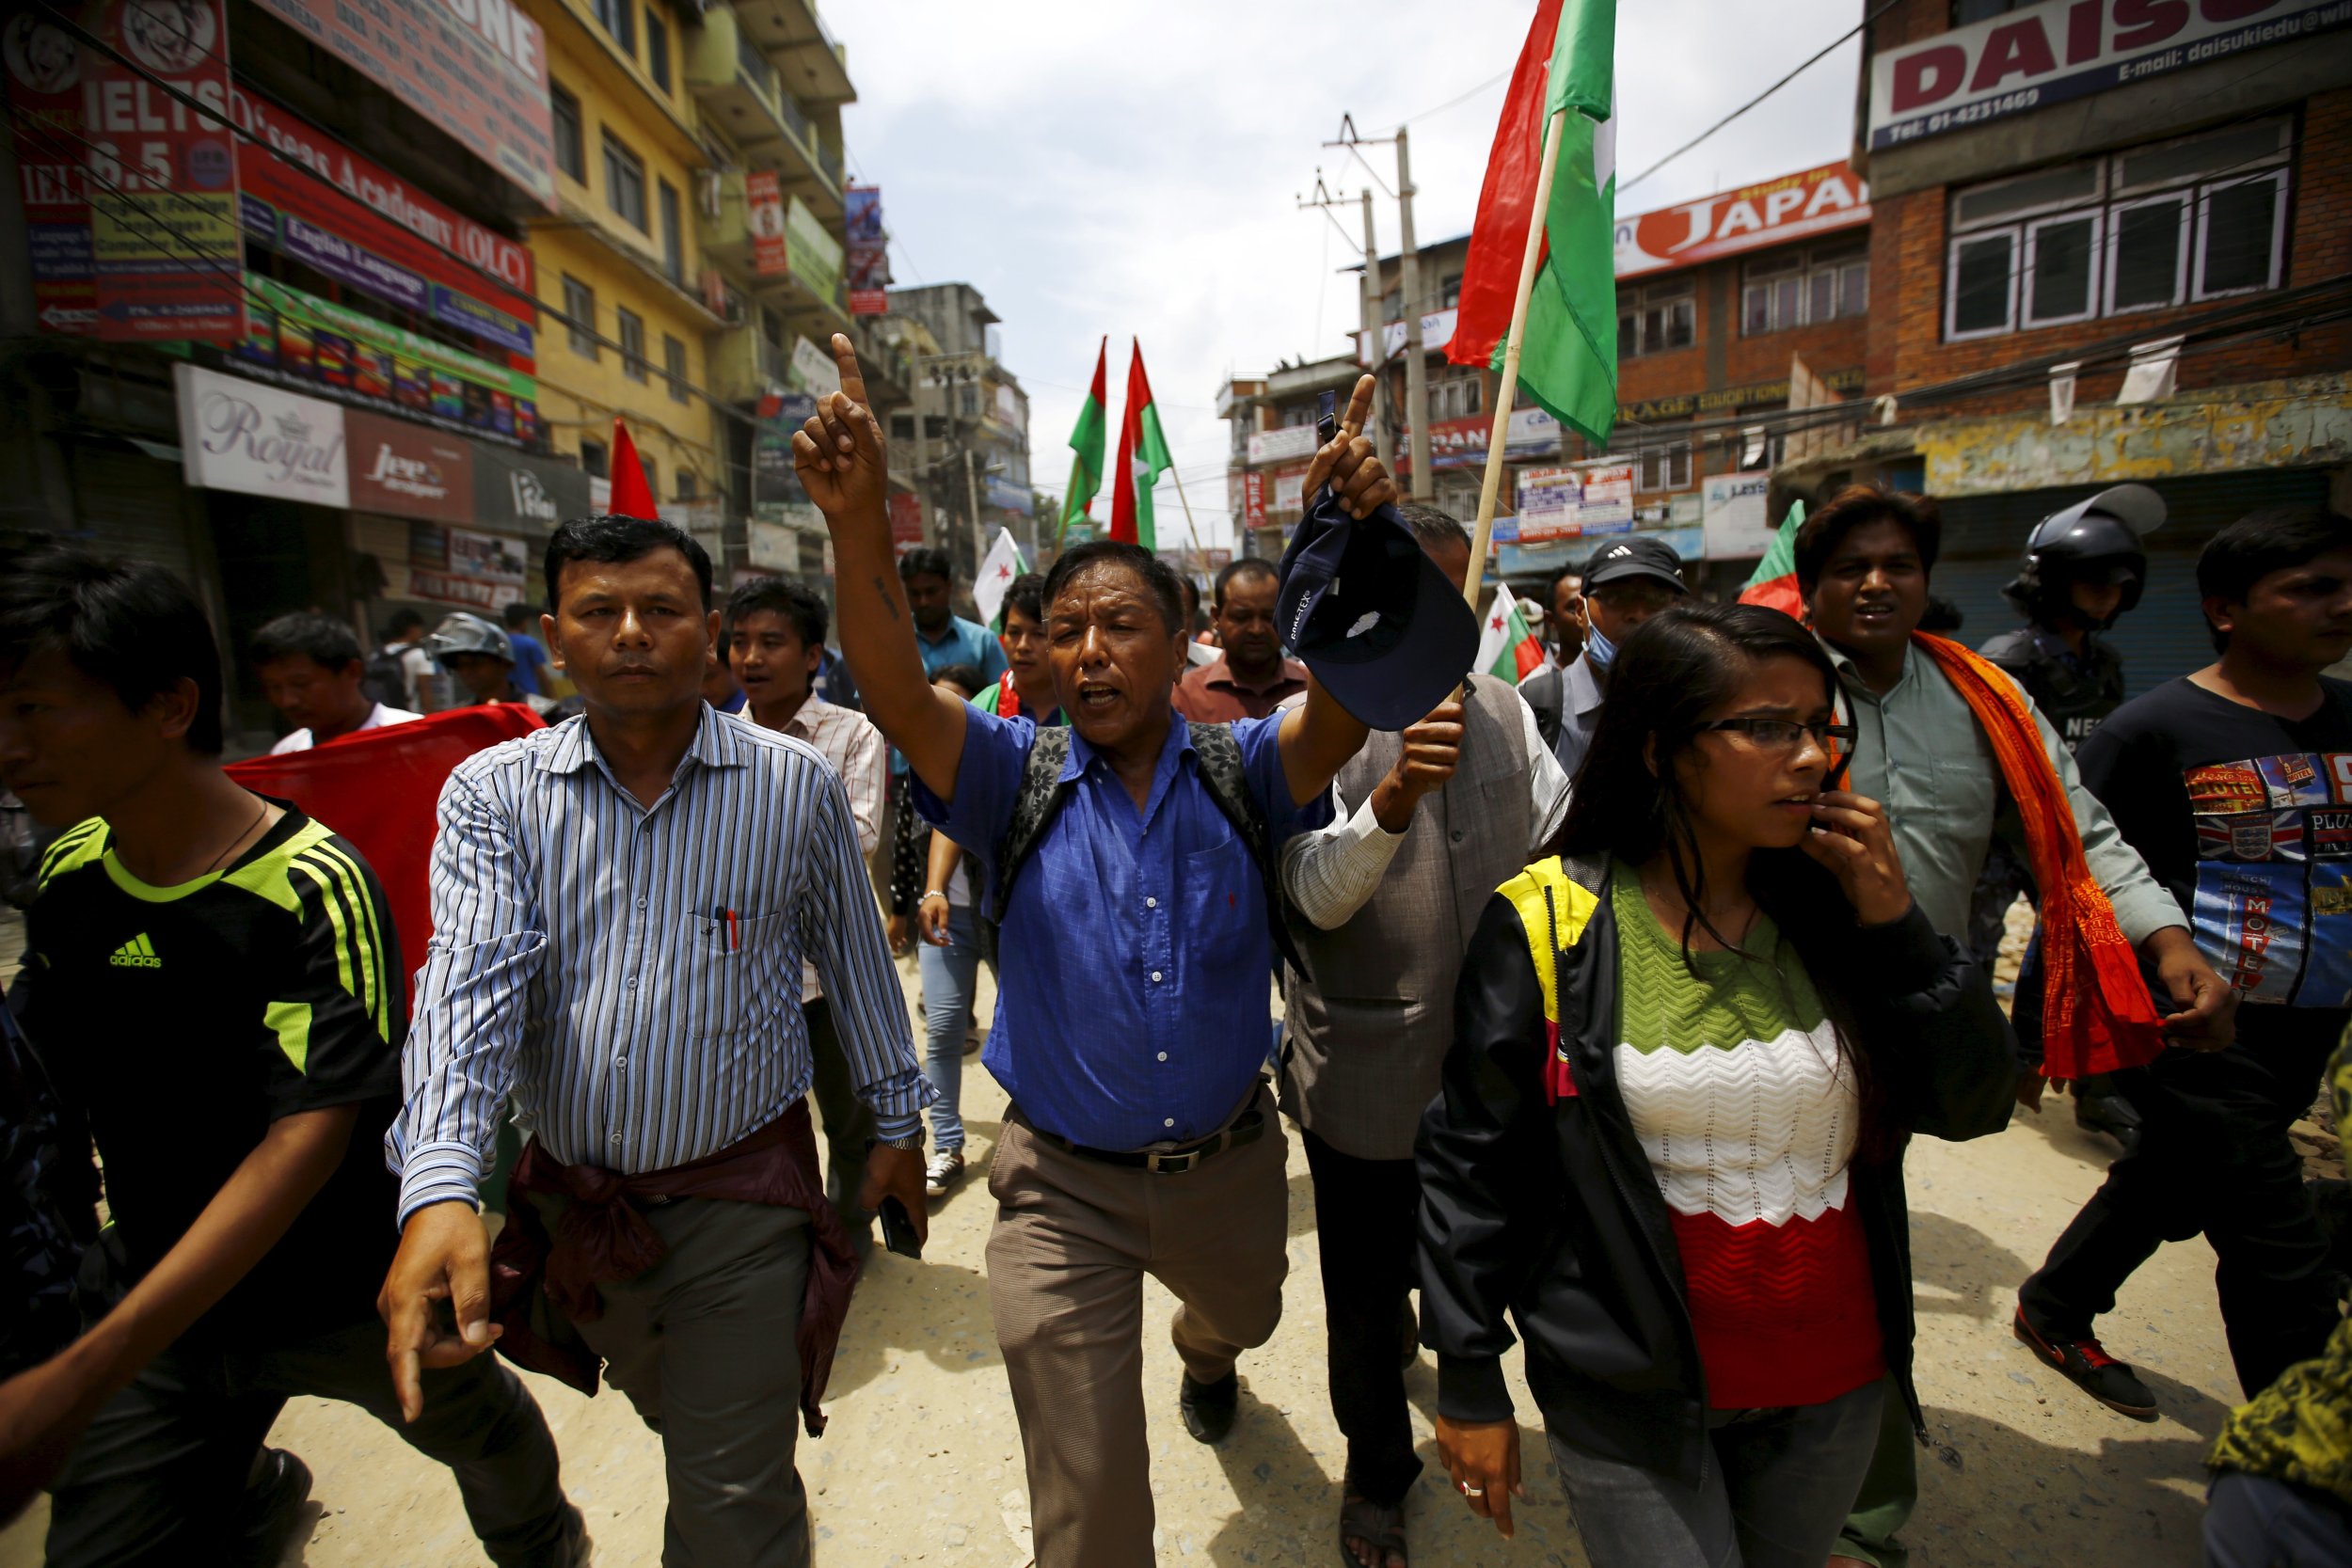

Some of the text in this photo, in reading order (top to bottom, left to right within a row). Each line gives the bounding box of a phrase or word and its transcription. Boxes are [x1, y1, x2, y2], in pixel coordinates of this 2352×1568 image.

[2119, 50, 2182, 81] E-mail:
[86, 79, 230, 133] IELTS
[1889, 119, 1925, 142] Tel:
[91, 142, 173, 190] 6.5
[201, 390, 345, 483] Royal
[2189, 781, 2263, 797] MOTEL
[2287, 769, 2313, 784] MOTEL
[2239, 898, 2266, 988] MOTEL
[109, 953, 162, 969] adidas
